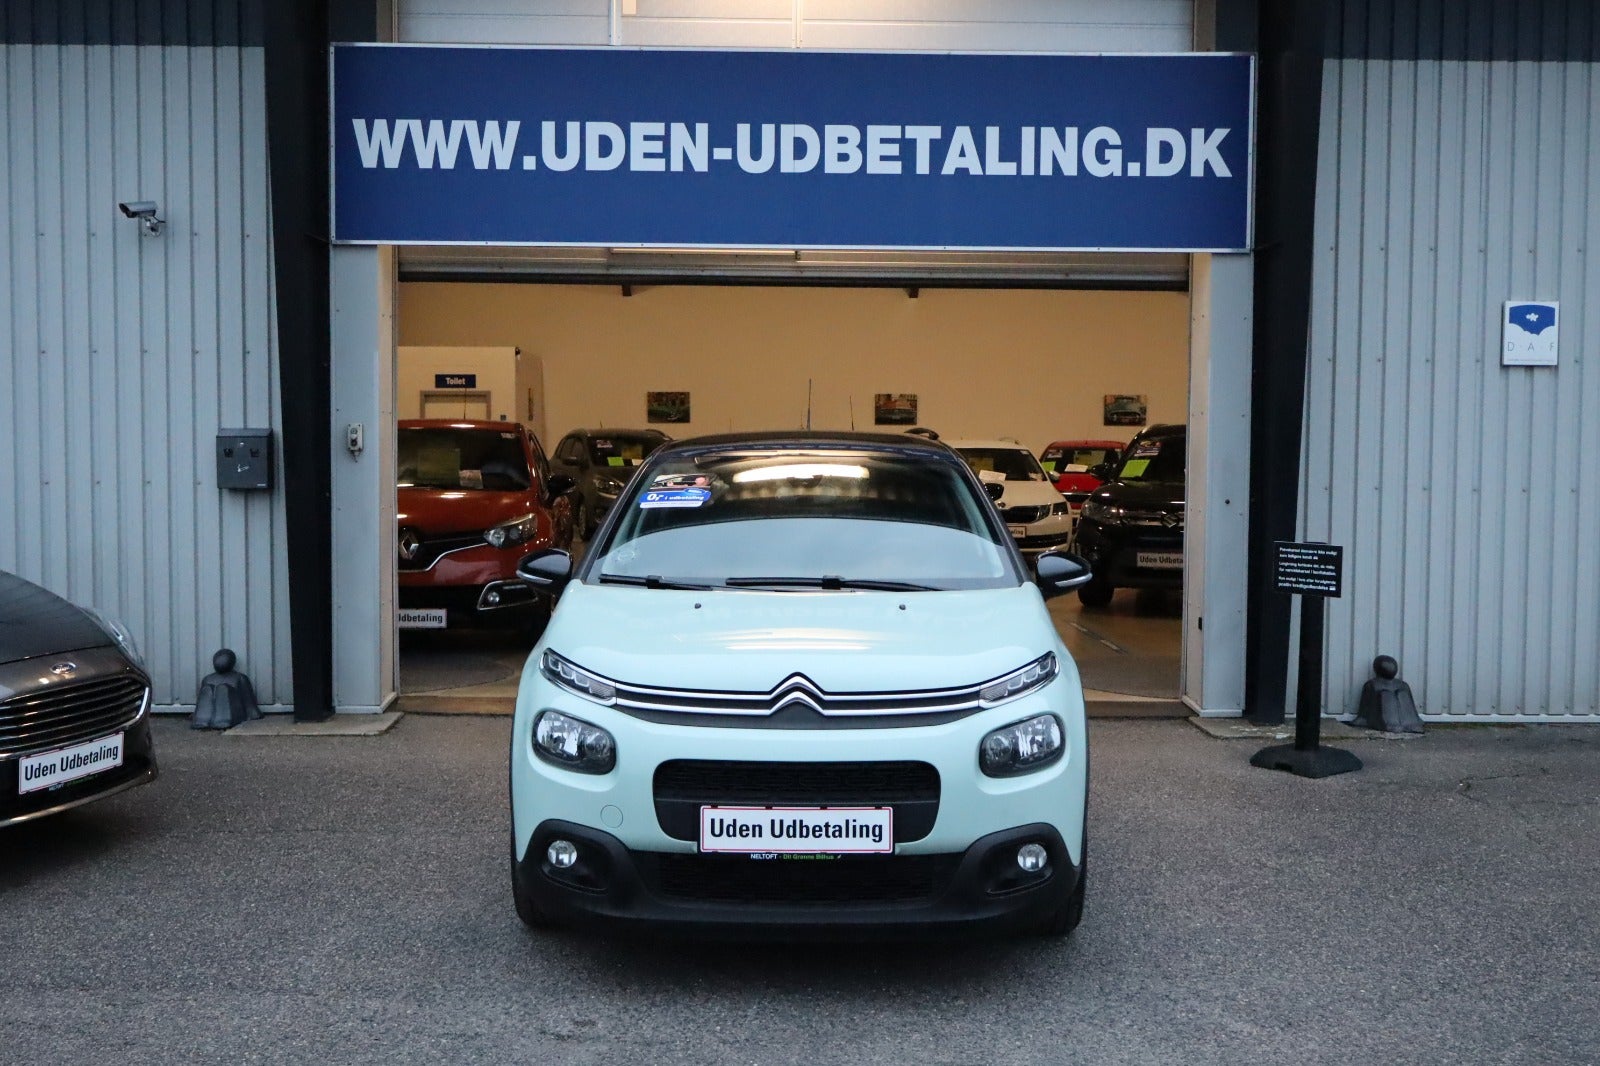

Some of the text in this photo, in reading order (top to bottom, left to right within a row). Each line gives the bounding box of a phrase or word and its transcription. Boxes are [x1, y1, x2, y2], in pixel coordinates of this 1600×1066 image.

[351, 118, 1233, 178] WWW.UDEN-UDBETALING.DK
[445, 377, 466, 385] Toilet
[1139, 555, 1157, 563] Uden
[24, 745, 119, 781] Uden Udbetaling
[710, 818, 883, 843] Uden Udbetaling
